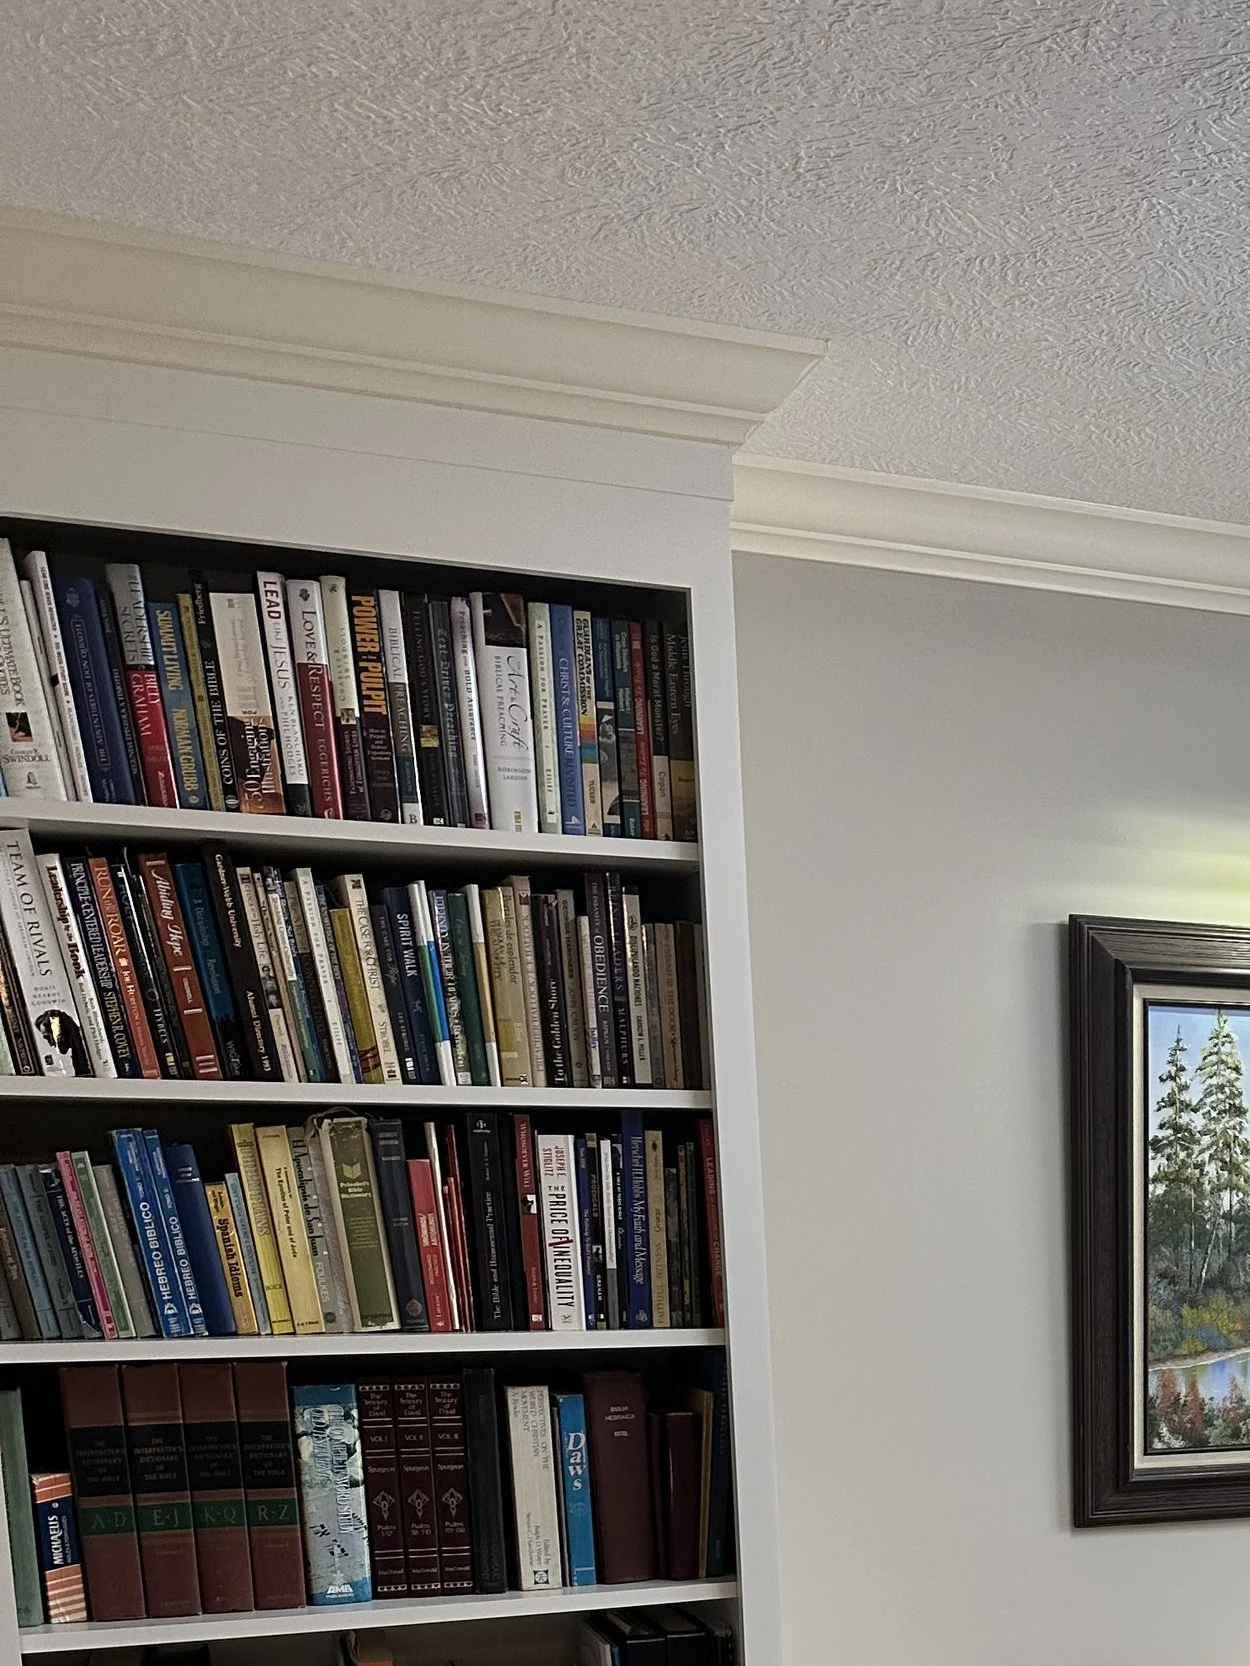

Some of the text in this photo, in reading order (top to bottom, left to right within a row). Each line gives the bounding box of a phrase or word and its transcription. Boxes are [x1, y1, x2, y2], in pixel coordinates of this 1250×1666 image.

[263, 580, 282, 620] LEAD
[351, 595, 380, 654] POWER
[156, 609, 183, 692] SUMMIT LIVING
[302, 610, 317, 651] LOVE
[11, 675, 25, 707] BOOK
[143, 673, 160, 705] BILLY
[270, 644, 290, 690] JESUS
[359, 661, 388, 715] PULPIT
[388, 627, 407, 754] BIBLICAL PREACHING
[559, 657, 570, 695] CHRIST
[130, 673, 152, 737] GRAHAM
[307, 663, 326, 730] RESPECT
[560, 697, 569, 706] &
[205, 660, 234, 786] COINS OF THE BIBLE
[561, 708, 574, 756] CULTURE
[4, 753, 51, 763] SWINDOLL
[172, 708, 198, 792] NORMAN GRUBB
[7, 840, 28, 889] TEAM
[21, 892, 37, 919] OF
[46, 865, 70, 926] Leadership
[95, 866, 127, 961] RUN ROAR
[27, 921, 53, 977] RIVALS
[227, 910, 243, 948] University
[358, 916, 369, 939] CASE
[367, 956, 382, 990] CHRIST
[396, 913, 418, 977] SPIRIT WALK
[90, 942, 113, 990] LEADERSHIP
[594, 934, 609, 1013] OBEDIENCE
[554, 1145, 565, 1169] JOSEPH
[549, 1193, 570, 1225] PRICE
[139, 1201, 173, 1301] HEBREO BIBLICO
[168, 1216, 197, 1301] HEBREO BIBLICO
[218, 1218, 243, 1298] Spanish Idioms
[553, 1246, 575, 1308] INEQUALITY
[315, 1261, 330, 1302] FOULKES
[258, 1504, 288, 1521] R-Z
[48, 1514, 65, 1565] MICHAELIS
